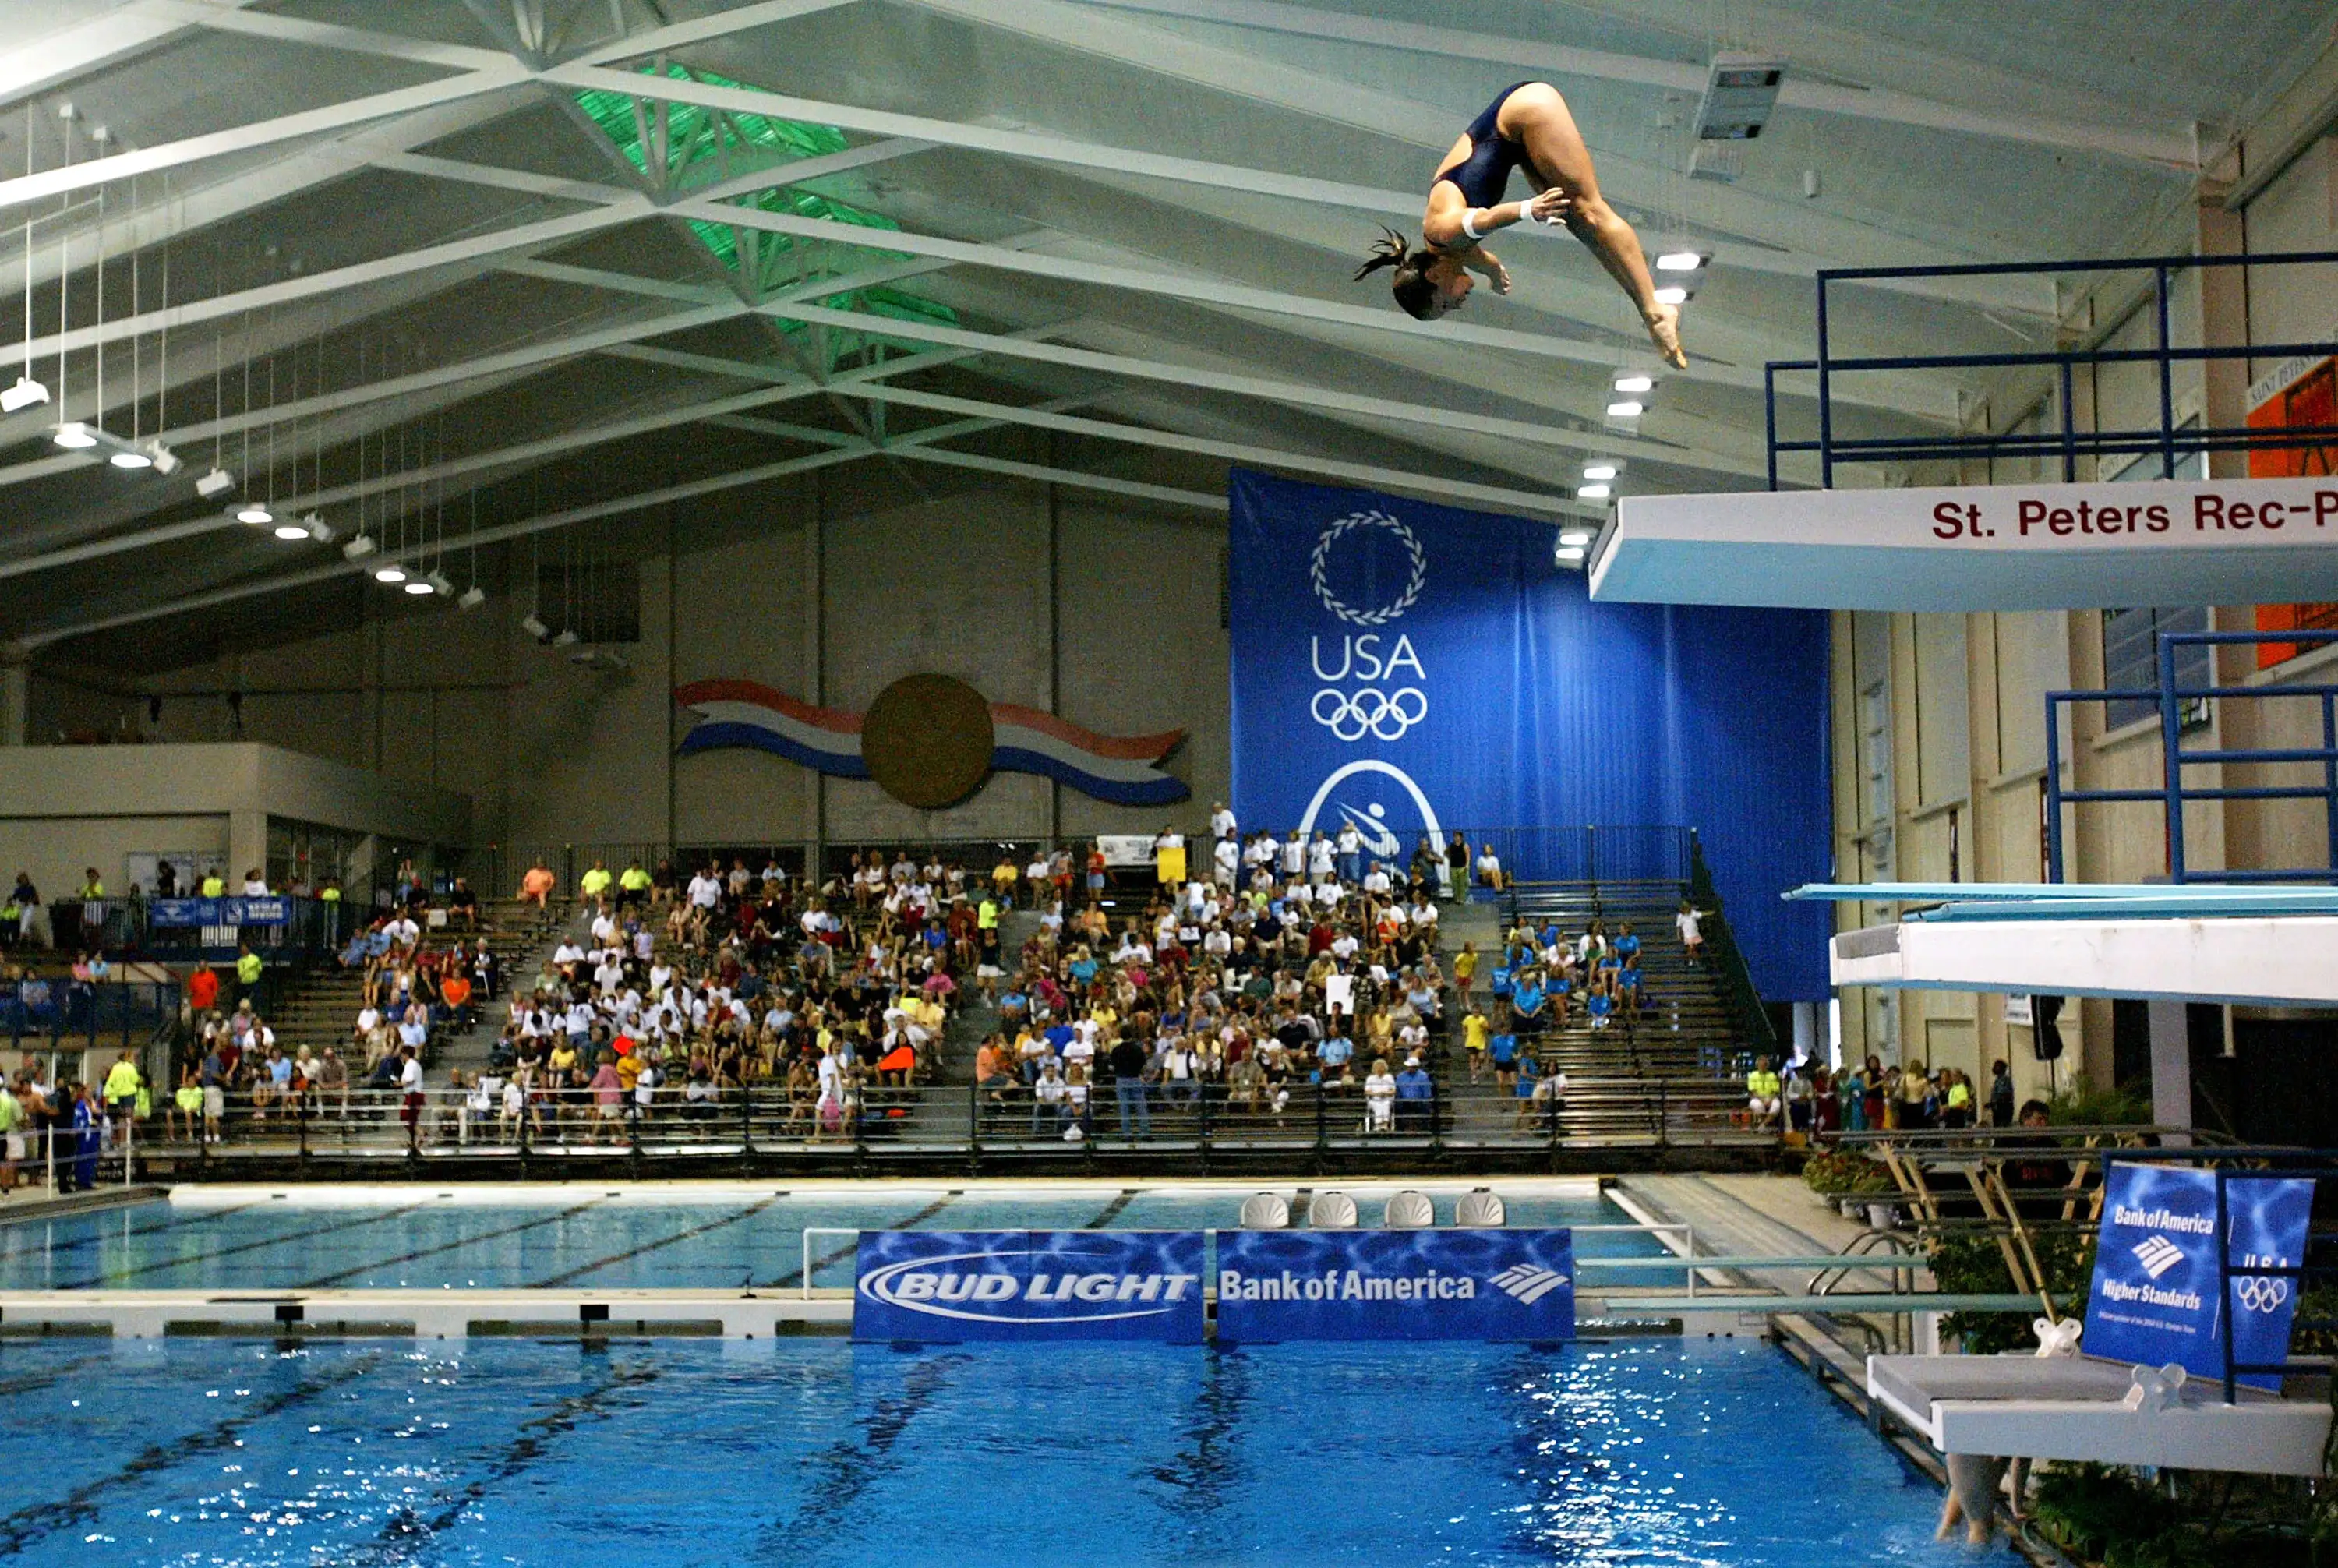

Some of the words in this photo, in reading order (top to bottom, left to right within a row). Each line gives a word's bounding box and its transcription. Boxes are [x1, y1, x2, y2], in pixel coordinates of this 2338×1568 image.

[1932, 501, 1995, 539] St.
[2018, 500, 2170, 536] Peters
[1311, 633, 1427, 682] USA
[2114, 1205, 2147, 1227] Bank
[2147, 1210, 2160, 1229] of
[2161, 1210, 2213, 1234] America
[894, 1273, 1020, 1301] BUD
[1023, 1273, 1200, 1302] LIGHT
[1220, 1270, 1301, 1301] Bank
[1305, 1270, 1339, 1301] of
[1341, 1269, 1475, 1301] America
[2101, 1278, 2140, 1302] Higher
[2141, 1284, 2202, 1311] Standards
